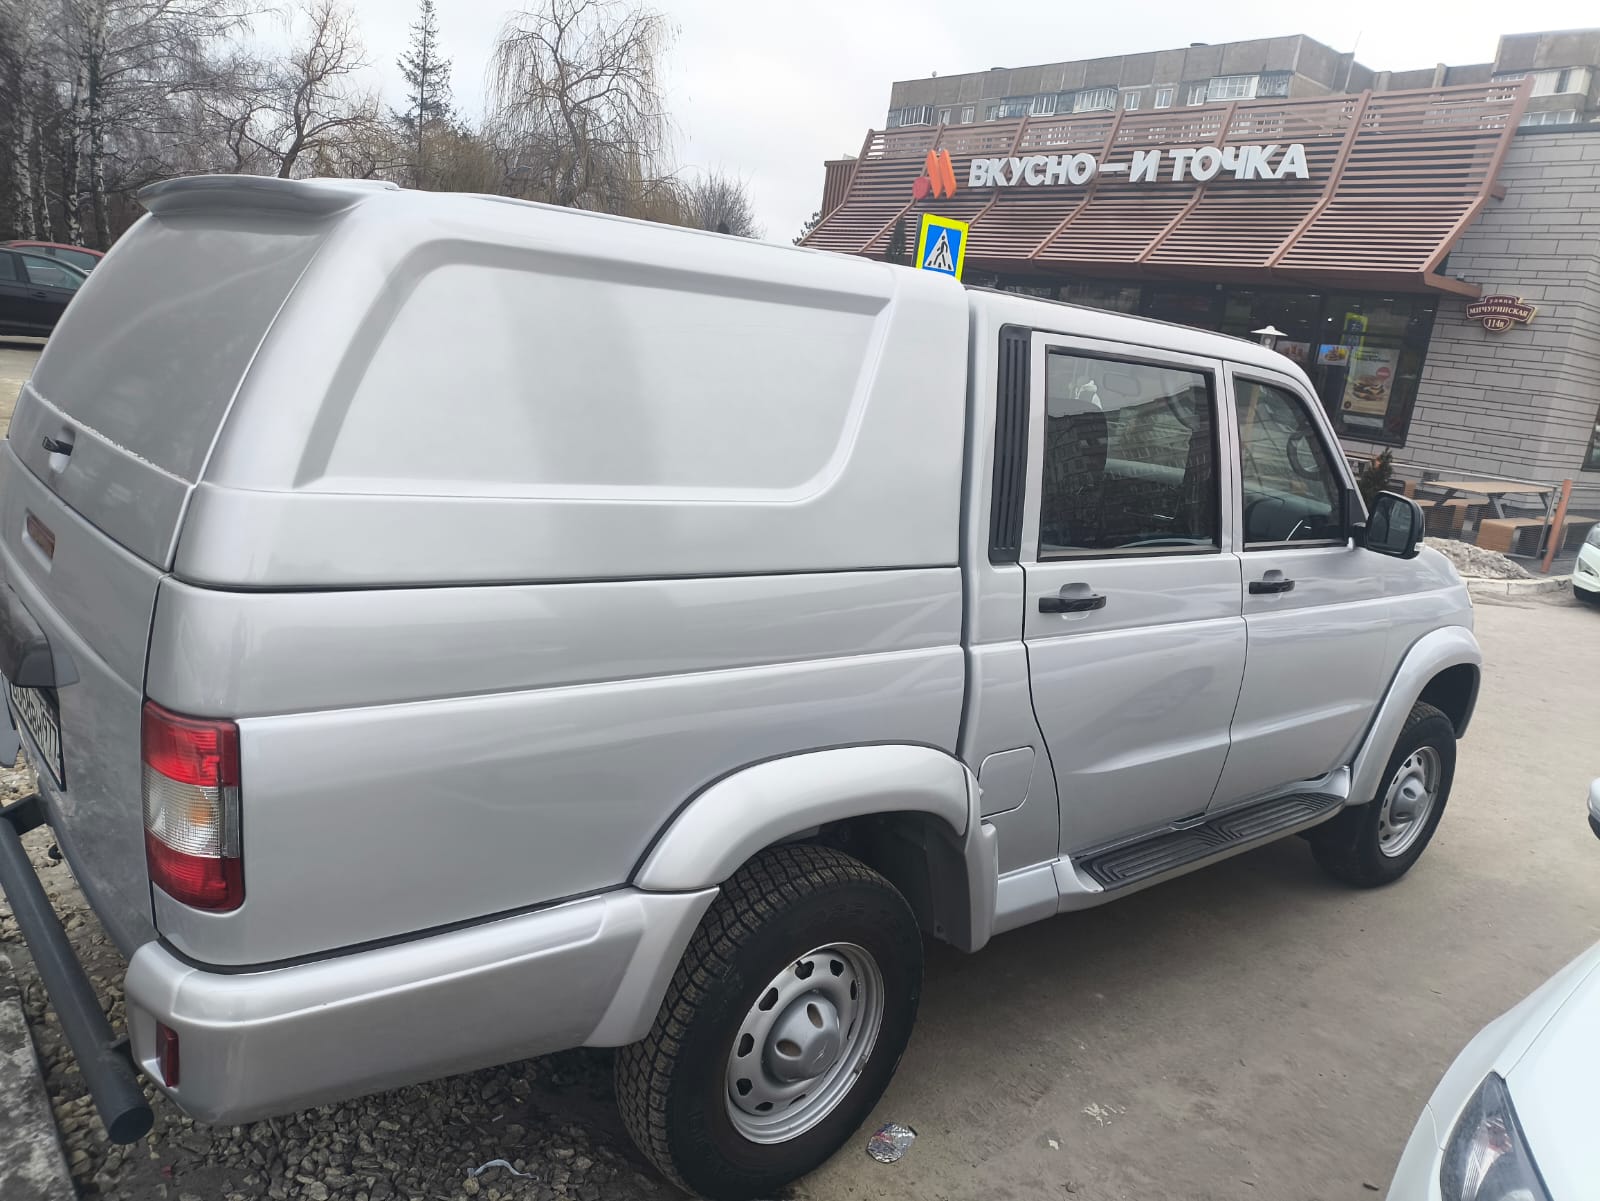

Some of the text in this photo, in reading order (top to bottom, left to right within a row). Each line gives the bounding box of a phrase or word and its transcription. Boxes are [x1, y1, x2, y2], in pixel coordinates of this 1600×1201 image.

[967, 152, 1098, 188] ВКУСНО
[1128, 149, 1162, 183] И
[1168, 143, 1310, 182] ТОЧКА
